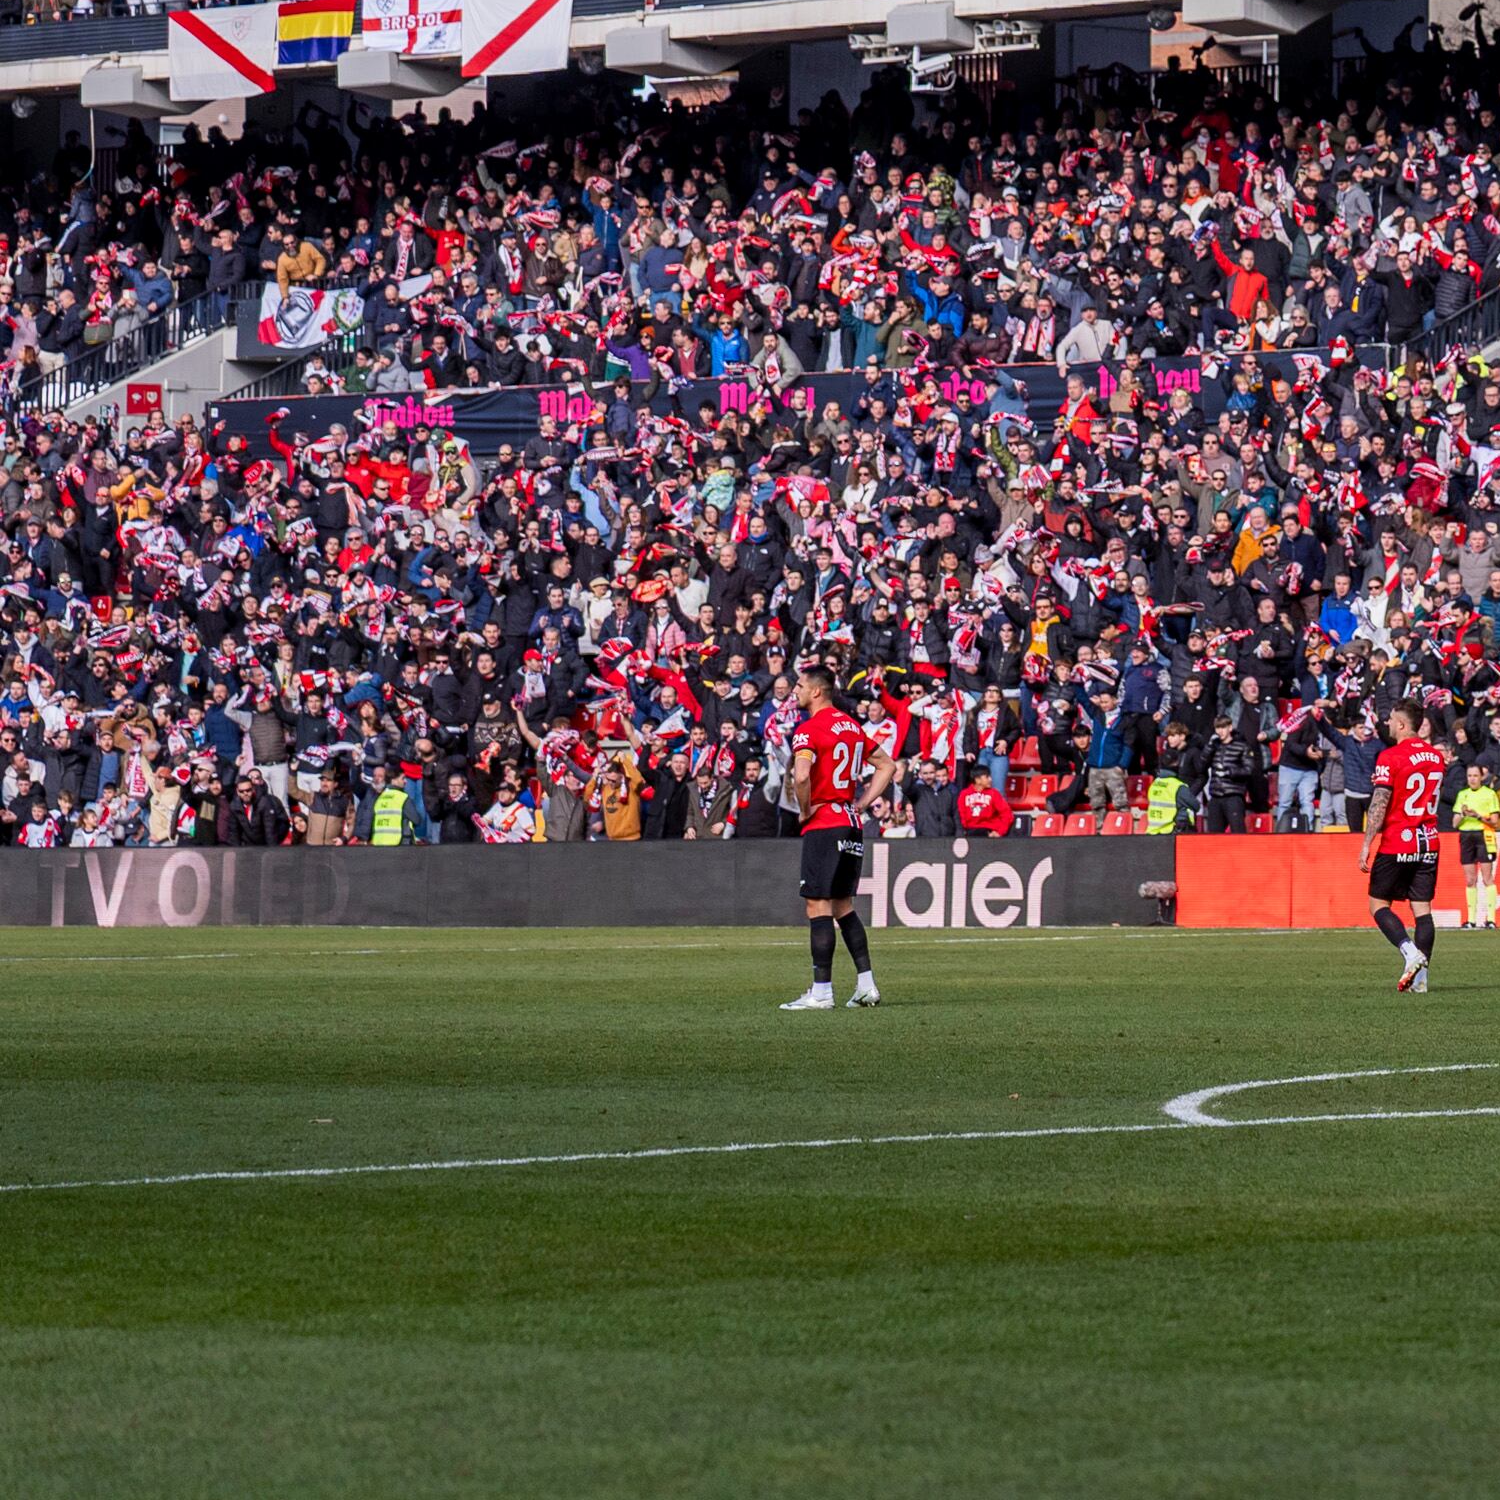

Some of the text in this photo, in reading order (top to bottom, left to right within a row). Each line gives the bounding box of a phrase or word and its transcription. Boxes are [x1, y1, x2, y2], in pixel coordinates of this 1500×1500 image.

[380, 12, 443, 30] BRISTOL
[832, 741, 864, 789] 24
[1409, 751, 1440, 766] MAFFEO
[1404, 771, 1444, 817] 23
[40, 850, 350, 927] TV OLED
[856, 837, 1053, 928] Haier
